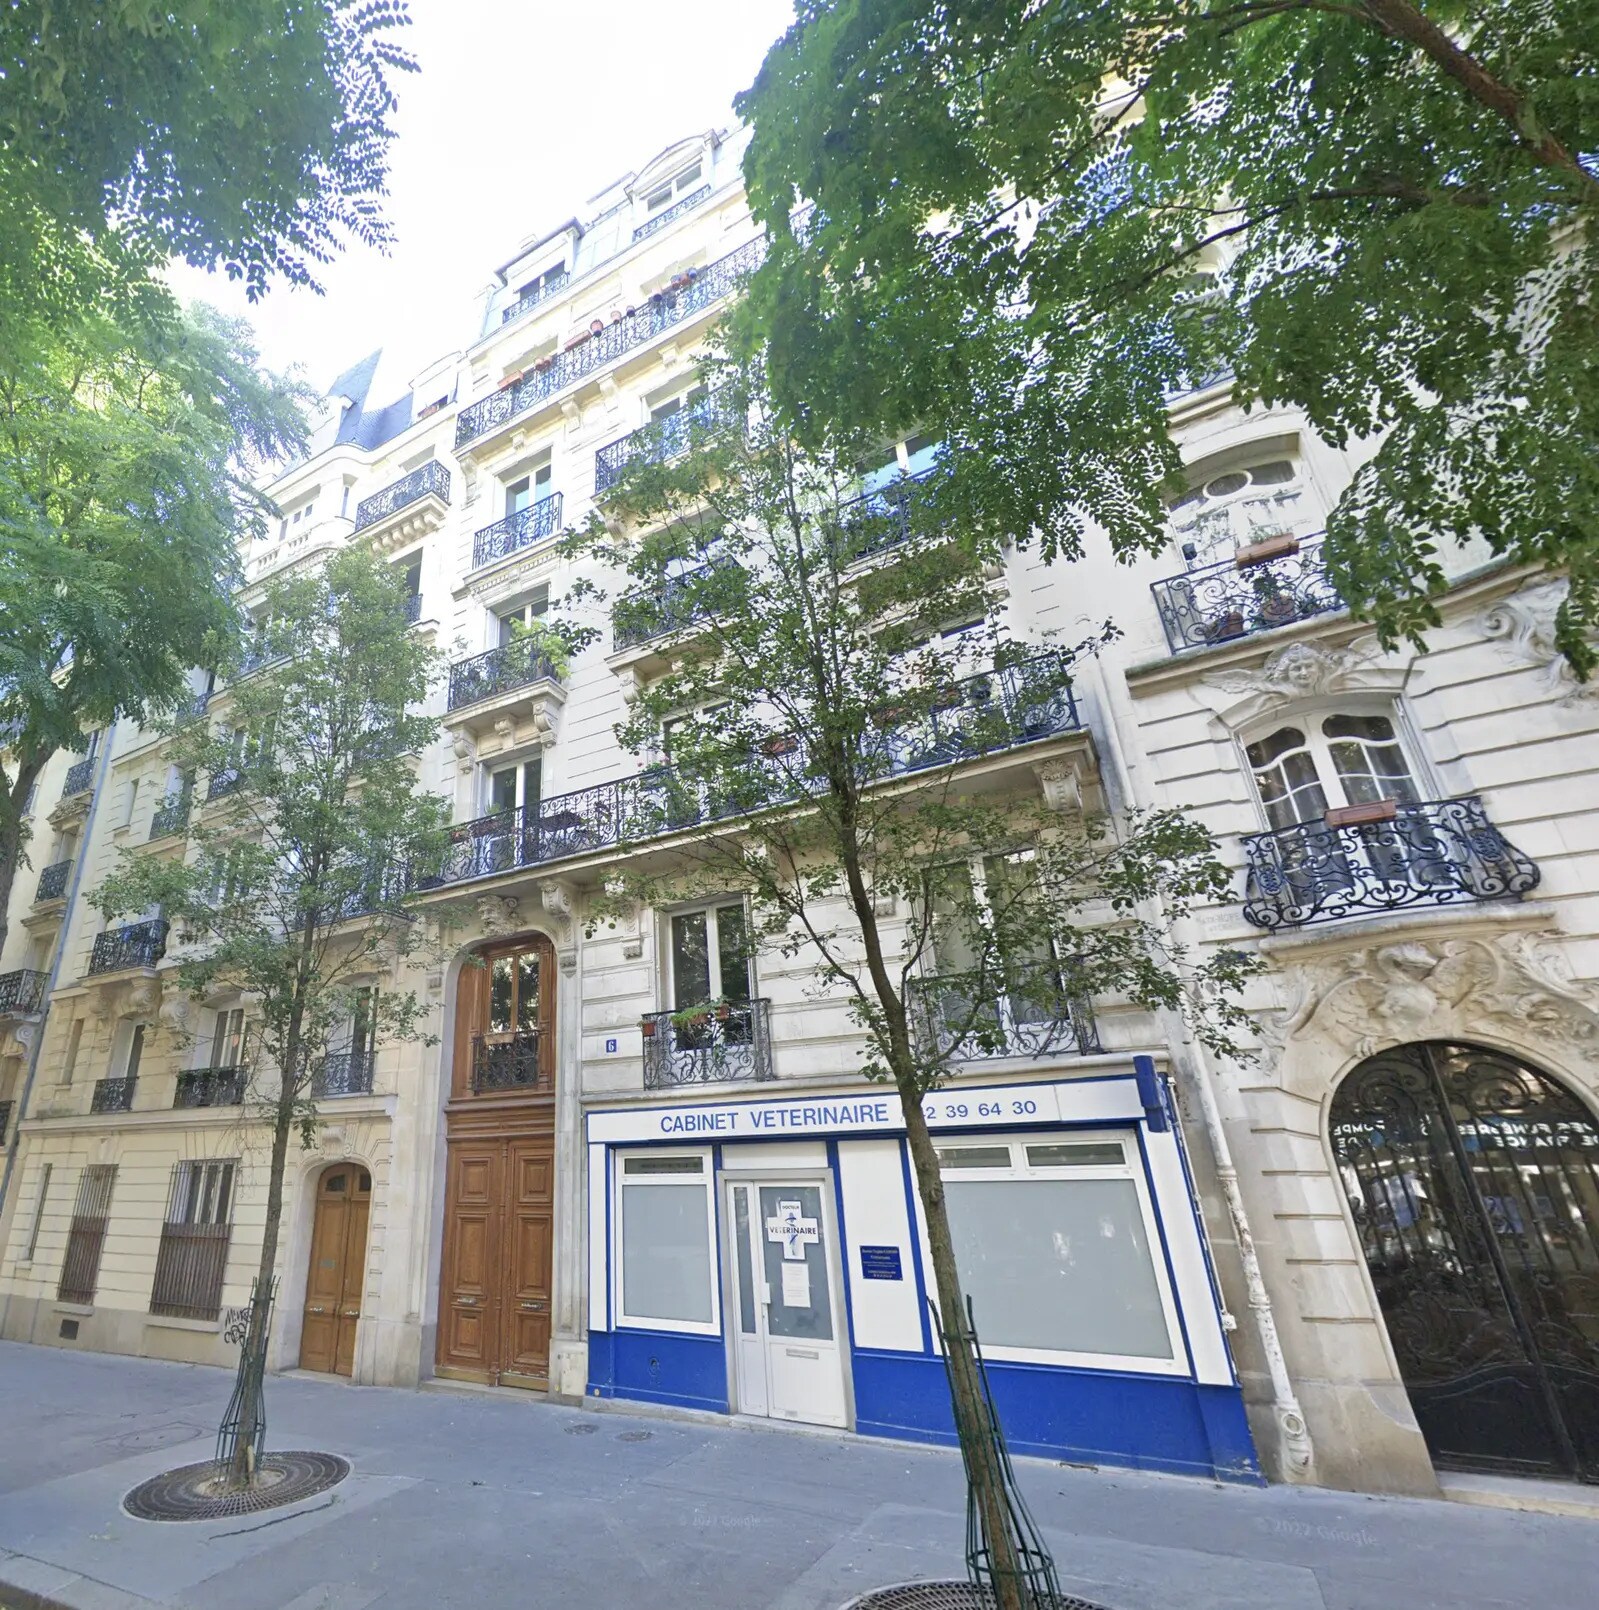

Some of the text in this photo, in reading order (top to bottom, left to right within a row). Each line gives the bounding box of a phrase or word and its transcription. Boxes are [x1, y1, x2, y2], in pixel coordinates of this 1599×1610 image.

[660, 1112, 739, 1133] CABINET
[750, 1103, 889, 1128] VETERINAIRE
[946, 1104, 969, 1118] 39
[978, 1102, 1002, 1117] 64
[1012, 1100, 1037, 1115] 30
